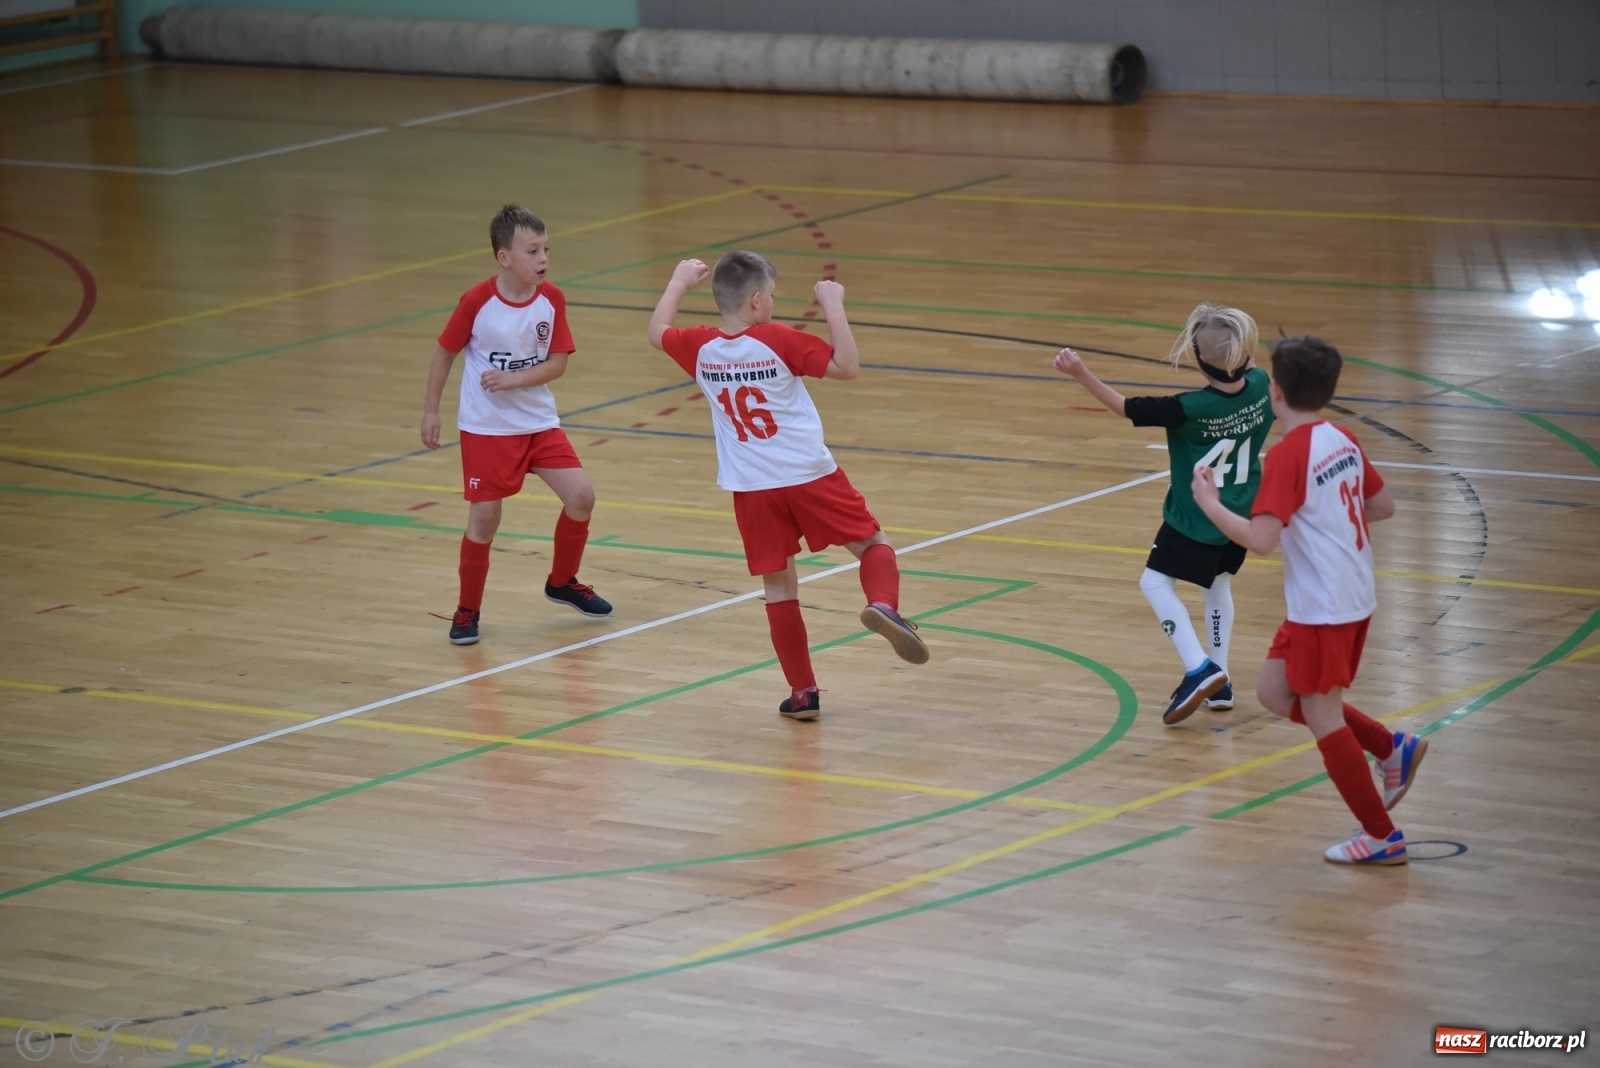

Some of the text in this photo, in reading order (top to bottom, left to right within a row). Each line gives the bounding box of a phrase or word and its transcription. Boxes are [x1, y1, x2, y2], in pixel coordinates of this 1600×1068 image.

[702, 367, 778, 383] RYMER RYBNIK
[717, 385, 779, 442] 16
[1193, 435, 1251, 488] 41
